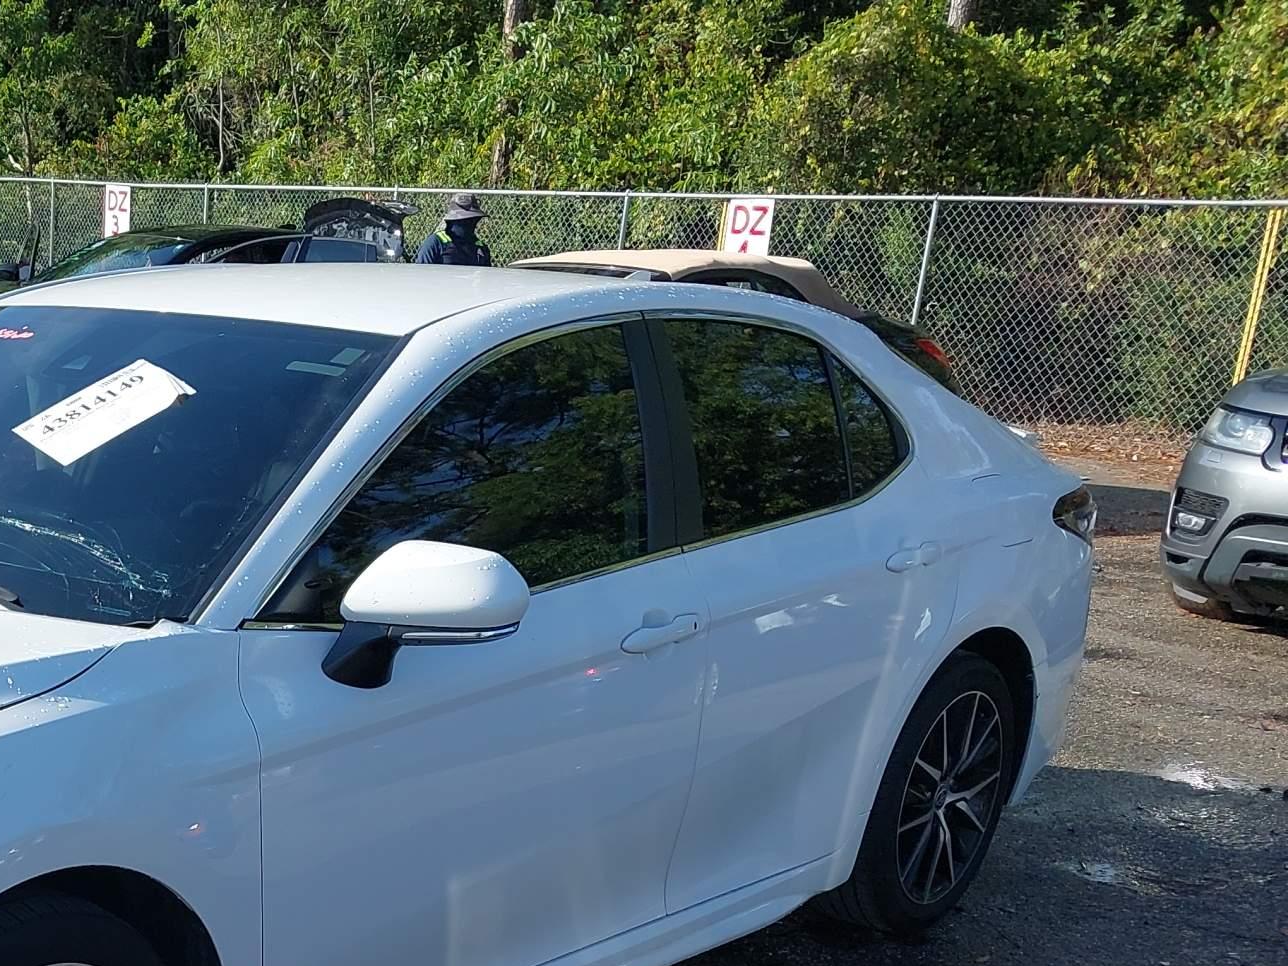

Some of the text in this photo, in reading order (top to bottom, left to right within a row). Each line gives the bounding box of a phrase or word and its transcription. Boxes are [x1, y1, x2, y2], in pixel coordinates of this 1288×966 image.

[108, 190, 128, 212] DZ
[112, 214, 120, 237] 3
[731, 205, 769, 235] DZ
[41, 375, 145, 436] 43814149
